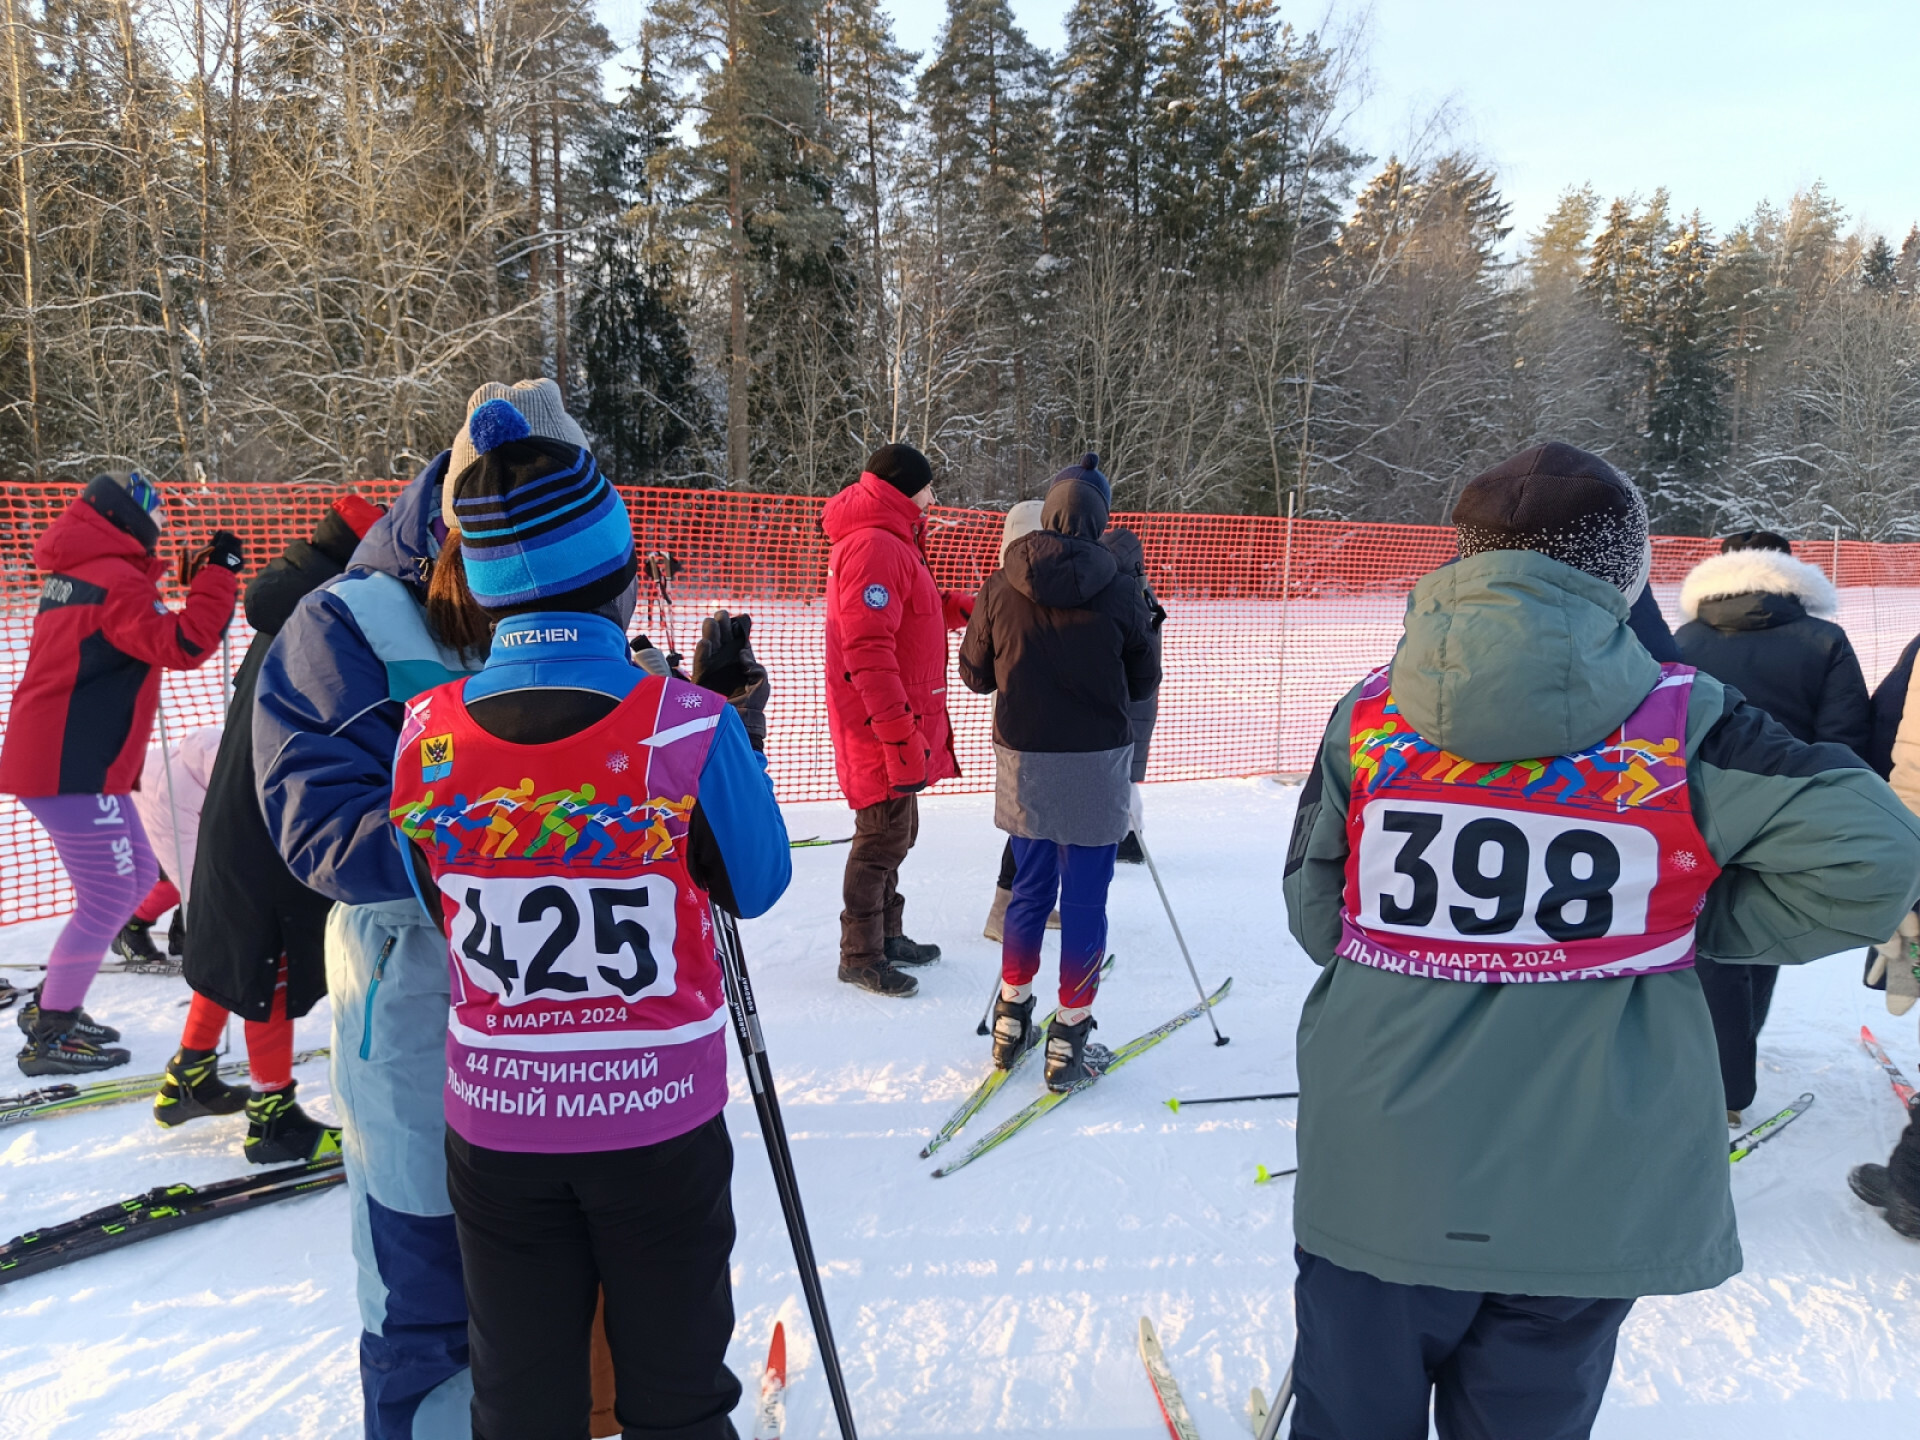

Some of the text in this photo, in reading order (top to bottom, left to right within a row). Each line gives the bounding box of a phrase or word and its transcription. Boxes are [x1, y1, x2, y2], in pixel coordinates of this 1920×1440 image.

[501, 628, 578, 648] VITZHEN
[111, 836, 136, 876] SKI
[1379, 809, 1621, 943] 398
[464, 884, 658, 998] 425
[1425, 952, 1507, 969] МАРТА
[1511, 949, 1567, 968] 2024
[741, 976, 755, 1012] NORDWAY
[486, 1007, 628, 1029] 8 МАРТА 2024
[733, 1002, 748, 1038] NORDWAY
[466, 1052, 659, 1083] 44 ГАТЧИНСКИЙ
[448, 1066, 695, 1117] ЛЫЖНЫЙ МАРАФОН
